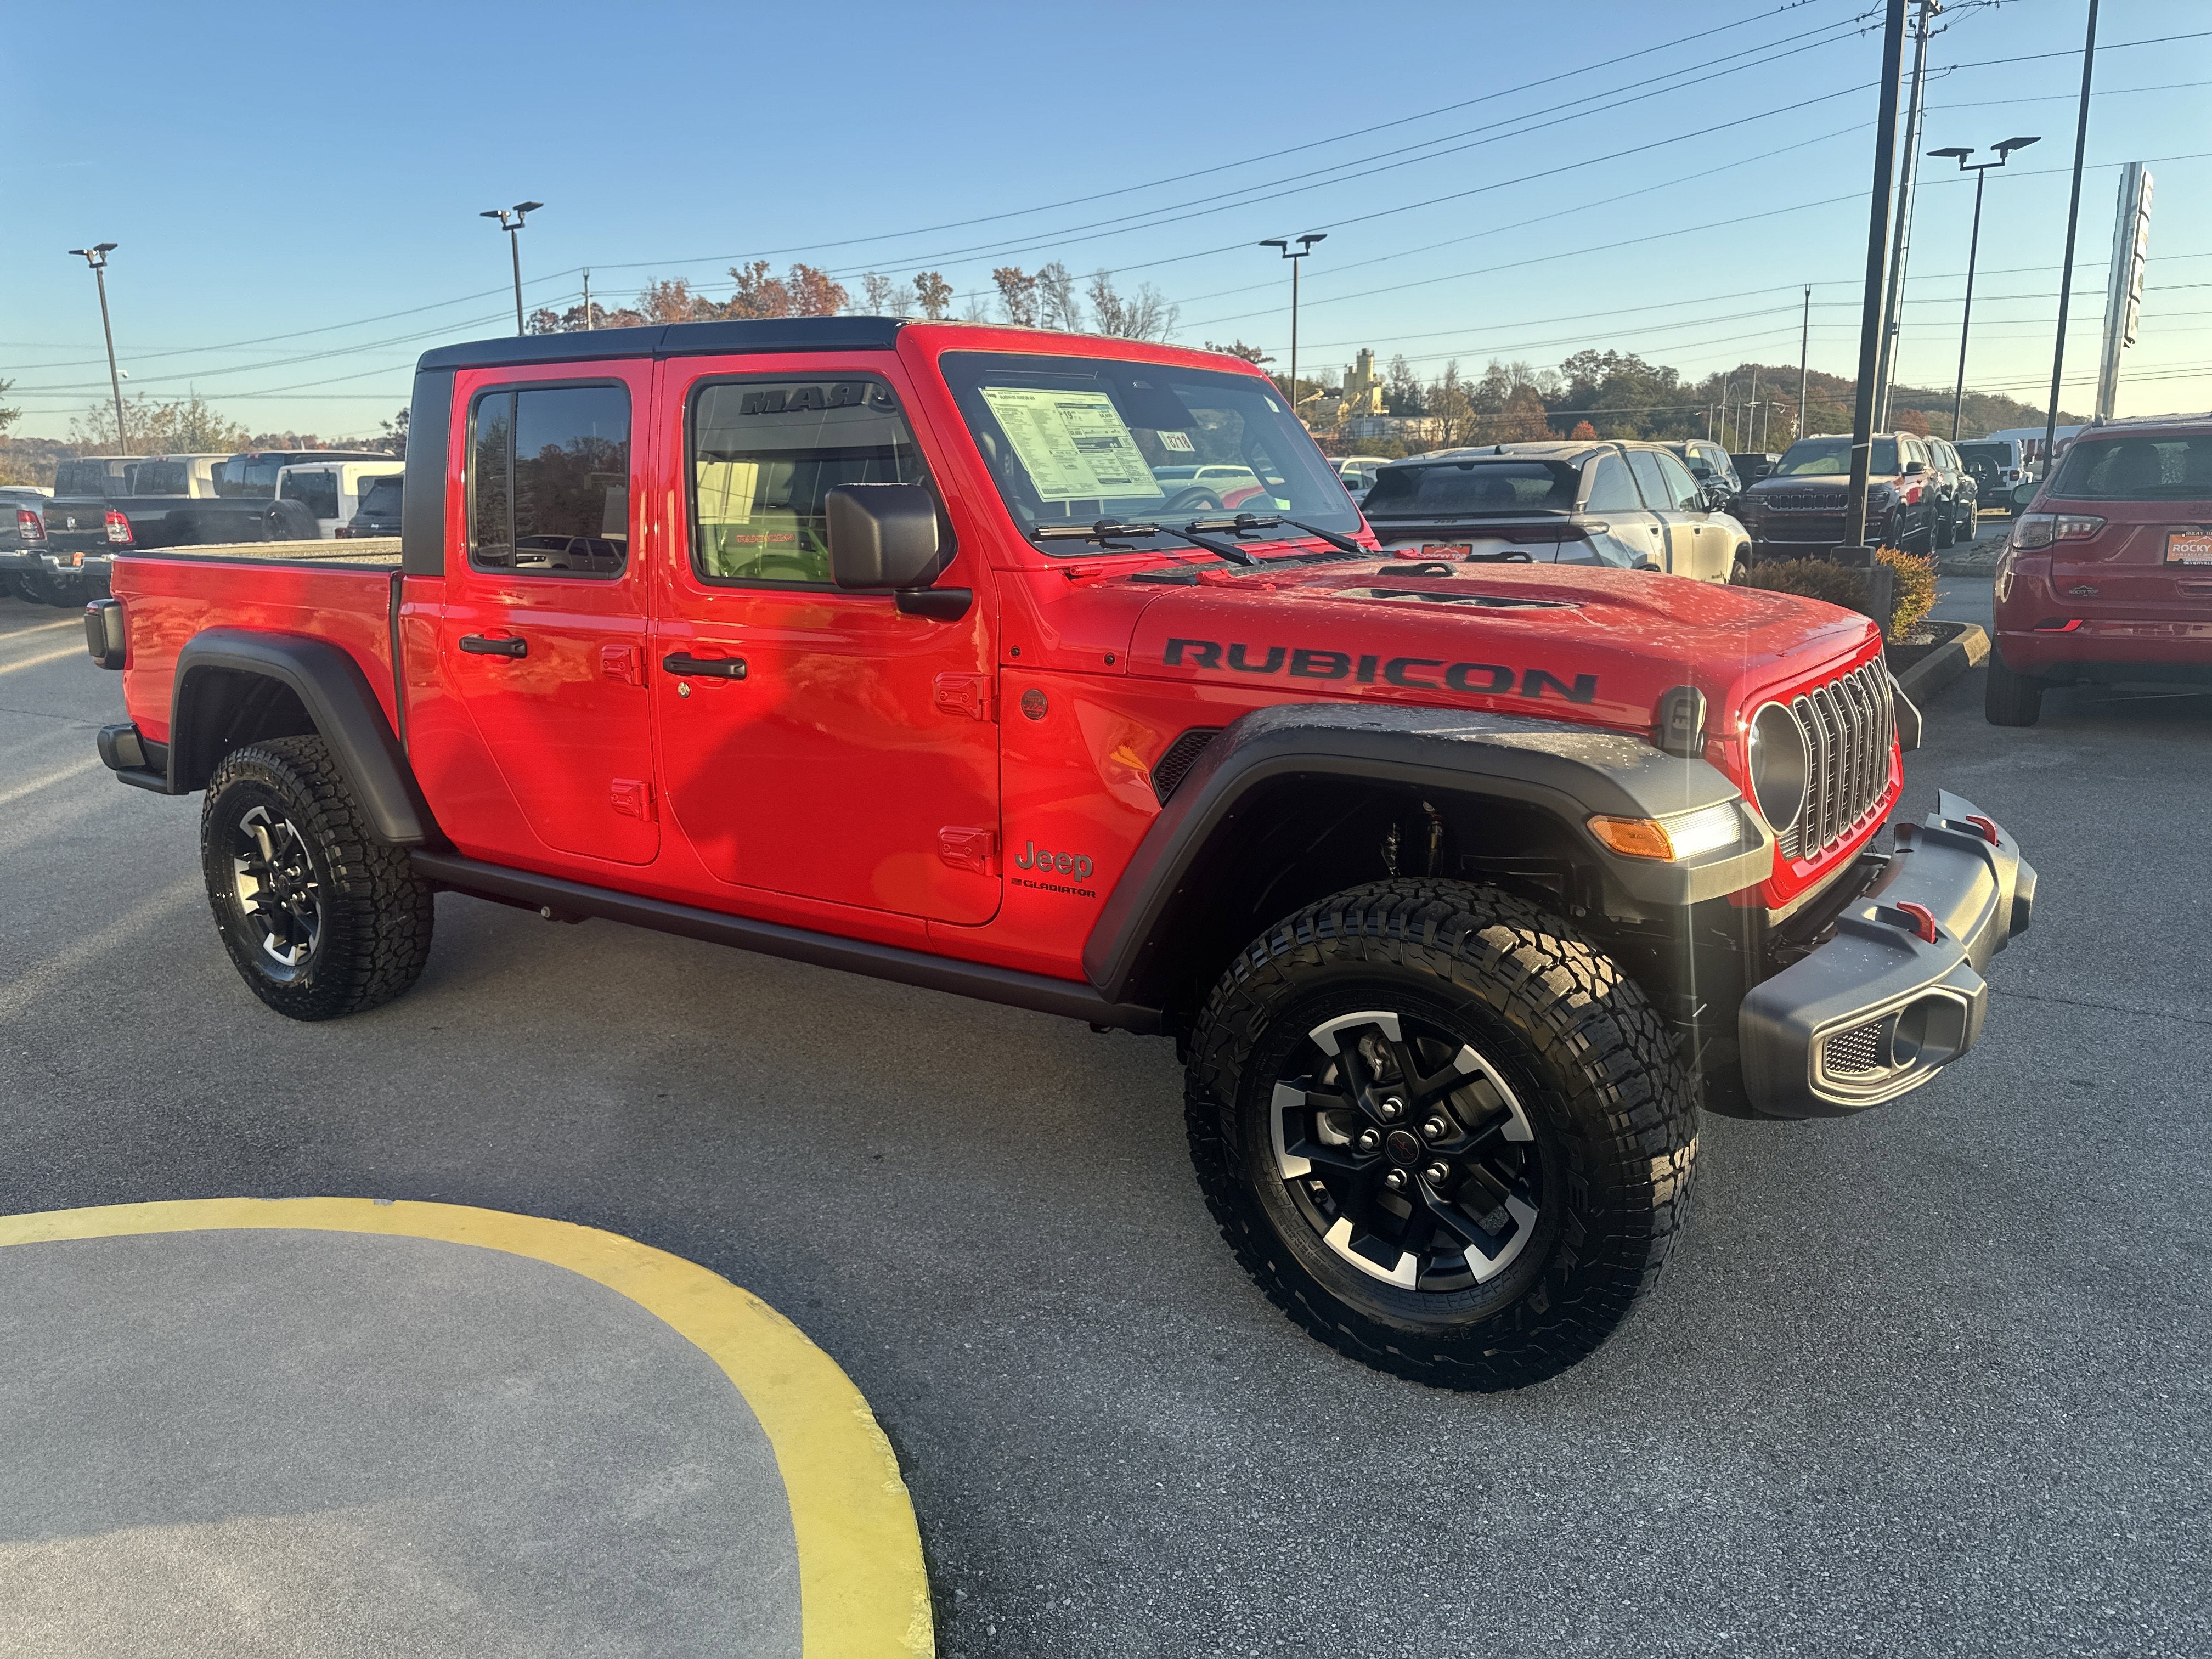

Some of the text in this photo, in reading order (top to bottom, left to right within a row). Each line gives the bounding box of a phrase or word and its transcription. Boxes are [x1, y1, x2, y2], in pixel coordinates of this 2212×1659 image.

[1063, 411, 1073, 419] 19
[1166, 435, 1190, 448] 8718
[736, 534, 794, 543] RUBICON
[1163, 638, 1600, 704] RUBICON
[1014, 840, 1093, 882] Jeep
[1023, 879, 1096, 898] GLADIATOR
